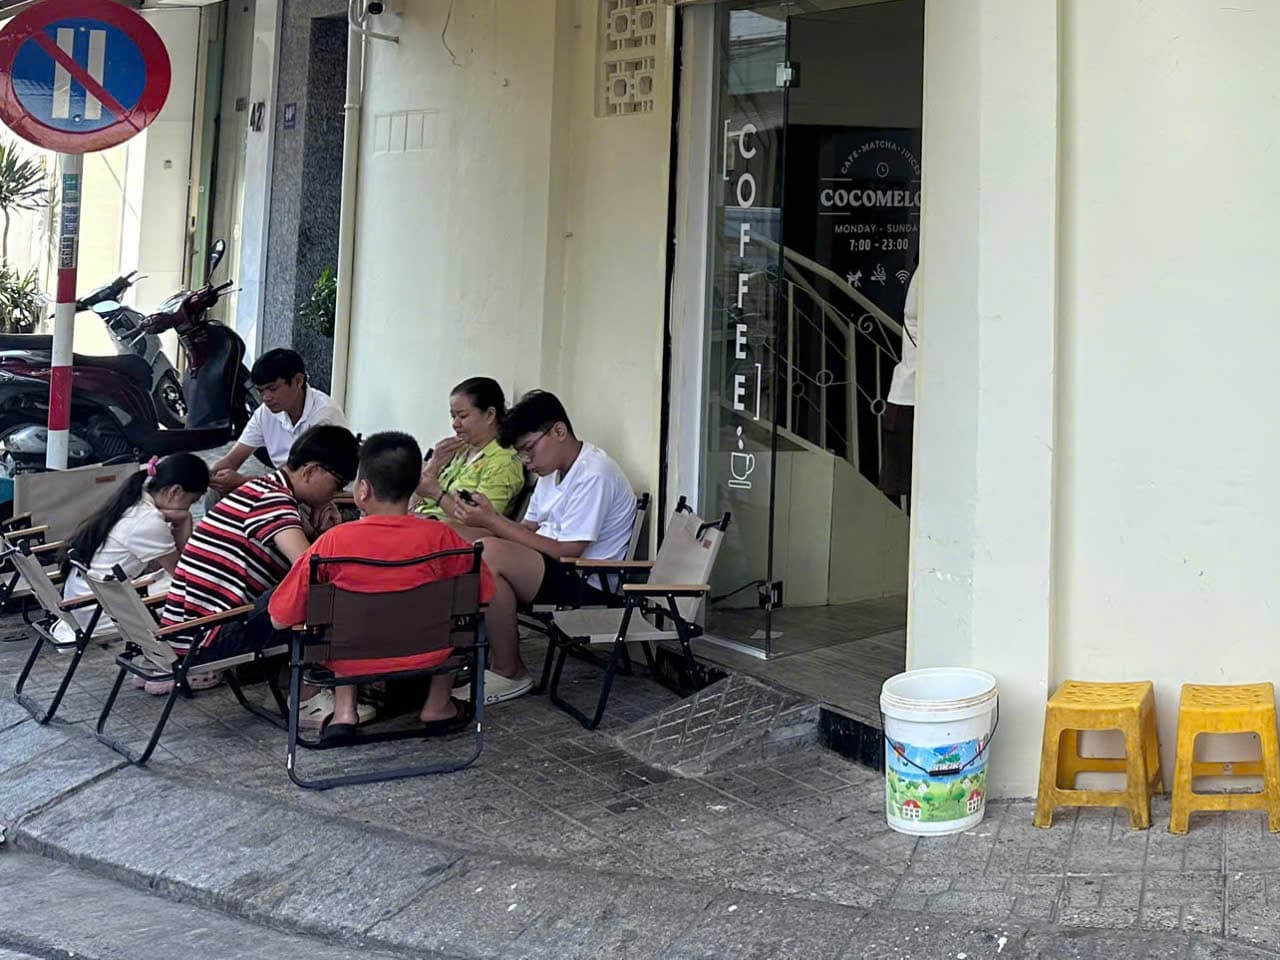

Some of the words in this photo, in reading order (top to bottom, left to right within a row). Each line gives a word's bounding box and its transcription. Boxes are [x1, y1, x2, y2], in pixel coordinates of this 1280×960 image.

[250, 102, 265, 132] 42
[861, 140, 897, 153] MATCHA
[835, 224, 877, 233] MONDAY
[887, 224, 920, 233] SUNDA
[850, 239, 871, 251] 7:00
[881, 239, 909, 251] 23:00
[733, 123, 758, 412] COFFEE
